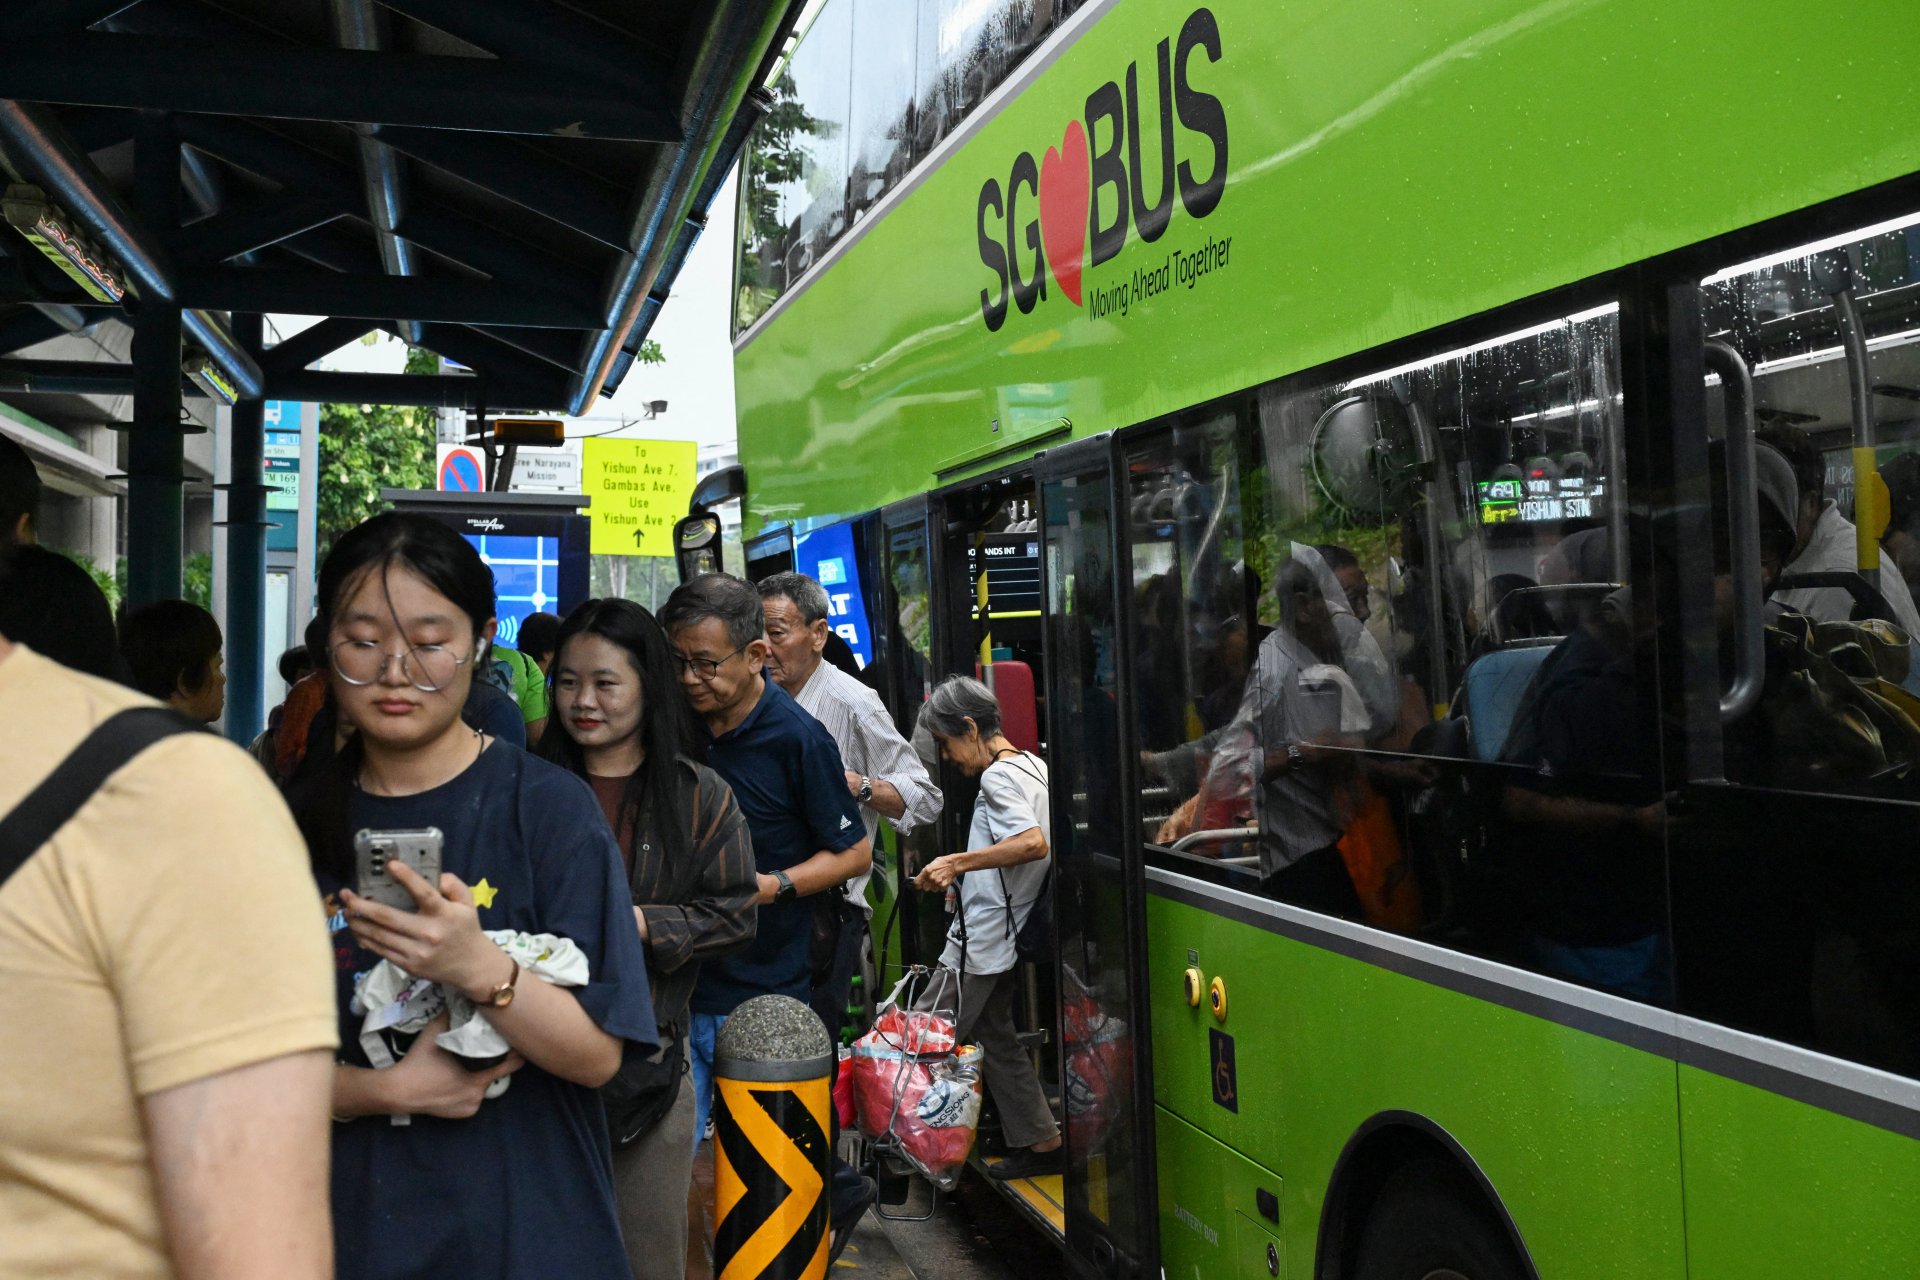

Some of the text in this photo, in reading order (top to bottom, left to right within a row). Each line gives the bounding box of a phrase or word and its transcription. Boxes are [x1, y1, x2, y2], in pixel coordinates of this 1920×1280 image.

[1089, 235, 1232, 322] Moving Ahead Together
[635, 445, 647, 458] To
[535, 458, 571, 469] Narayana
[602, 461, 637, 474] Yishun
[643, 463, 662, 475] Ave
[280, 474, 296, 483] 169
[527, 471, 557, 480] Mission
[603, 478, 646, 492] Gambas
[629, 496, 649, 509] Use
[603, 512, 677, 527] Yishun Ave 2
[1004, 546, 1016, 555] INT
